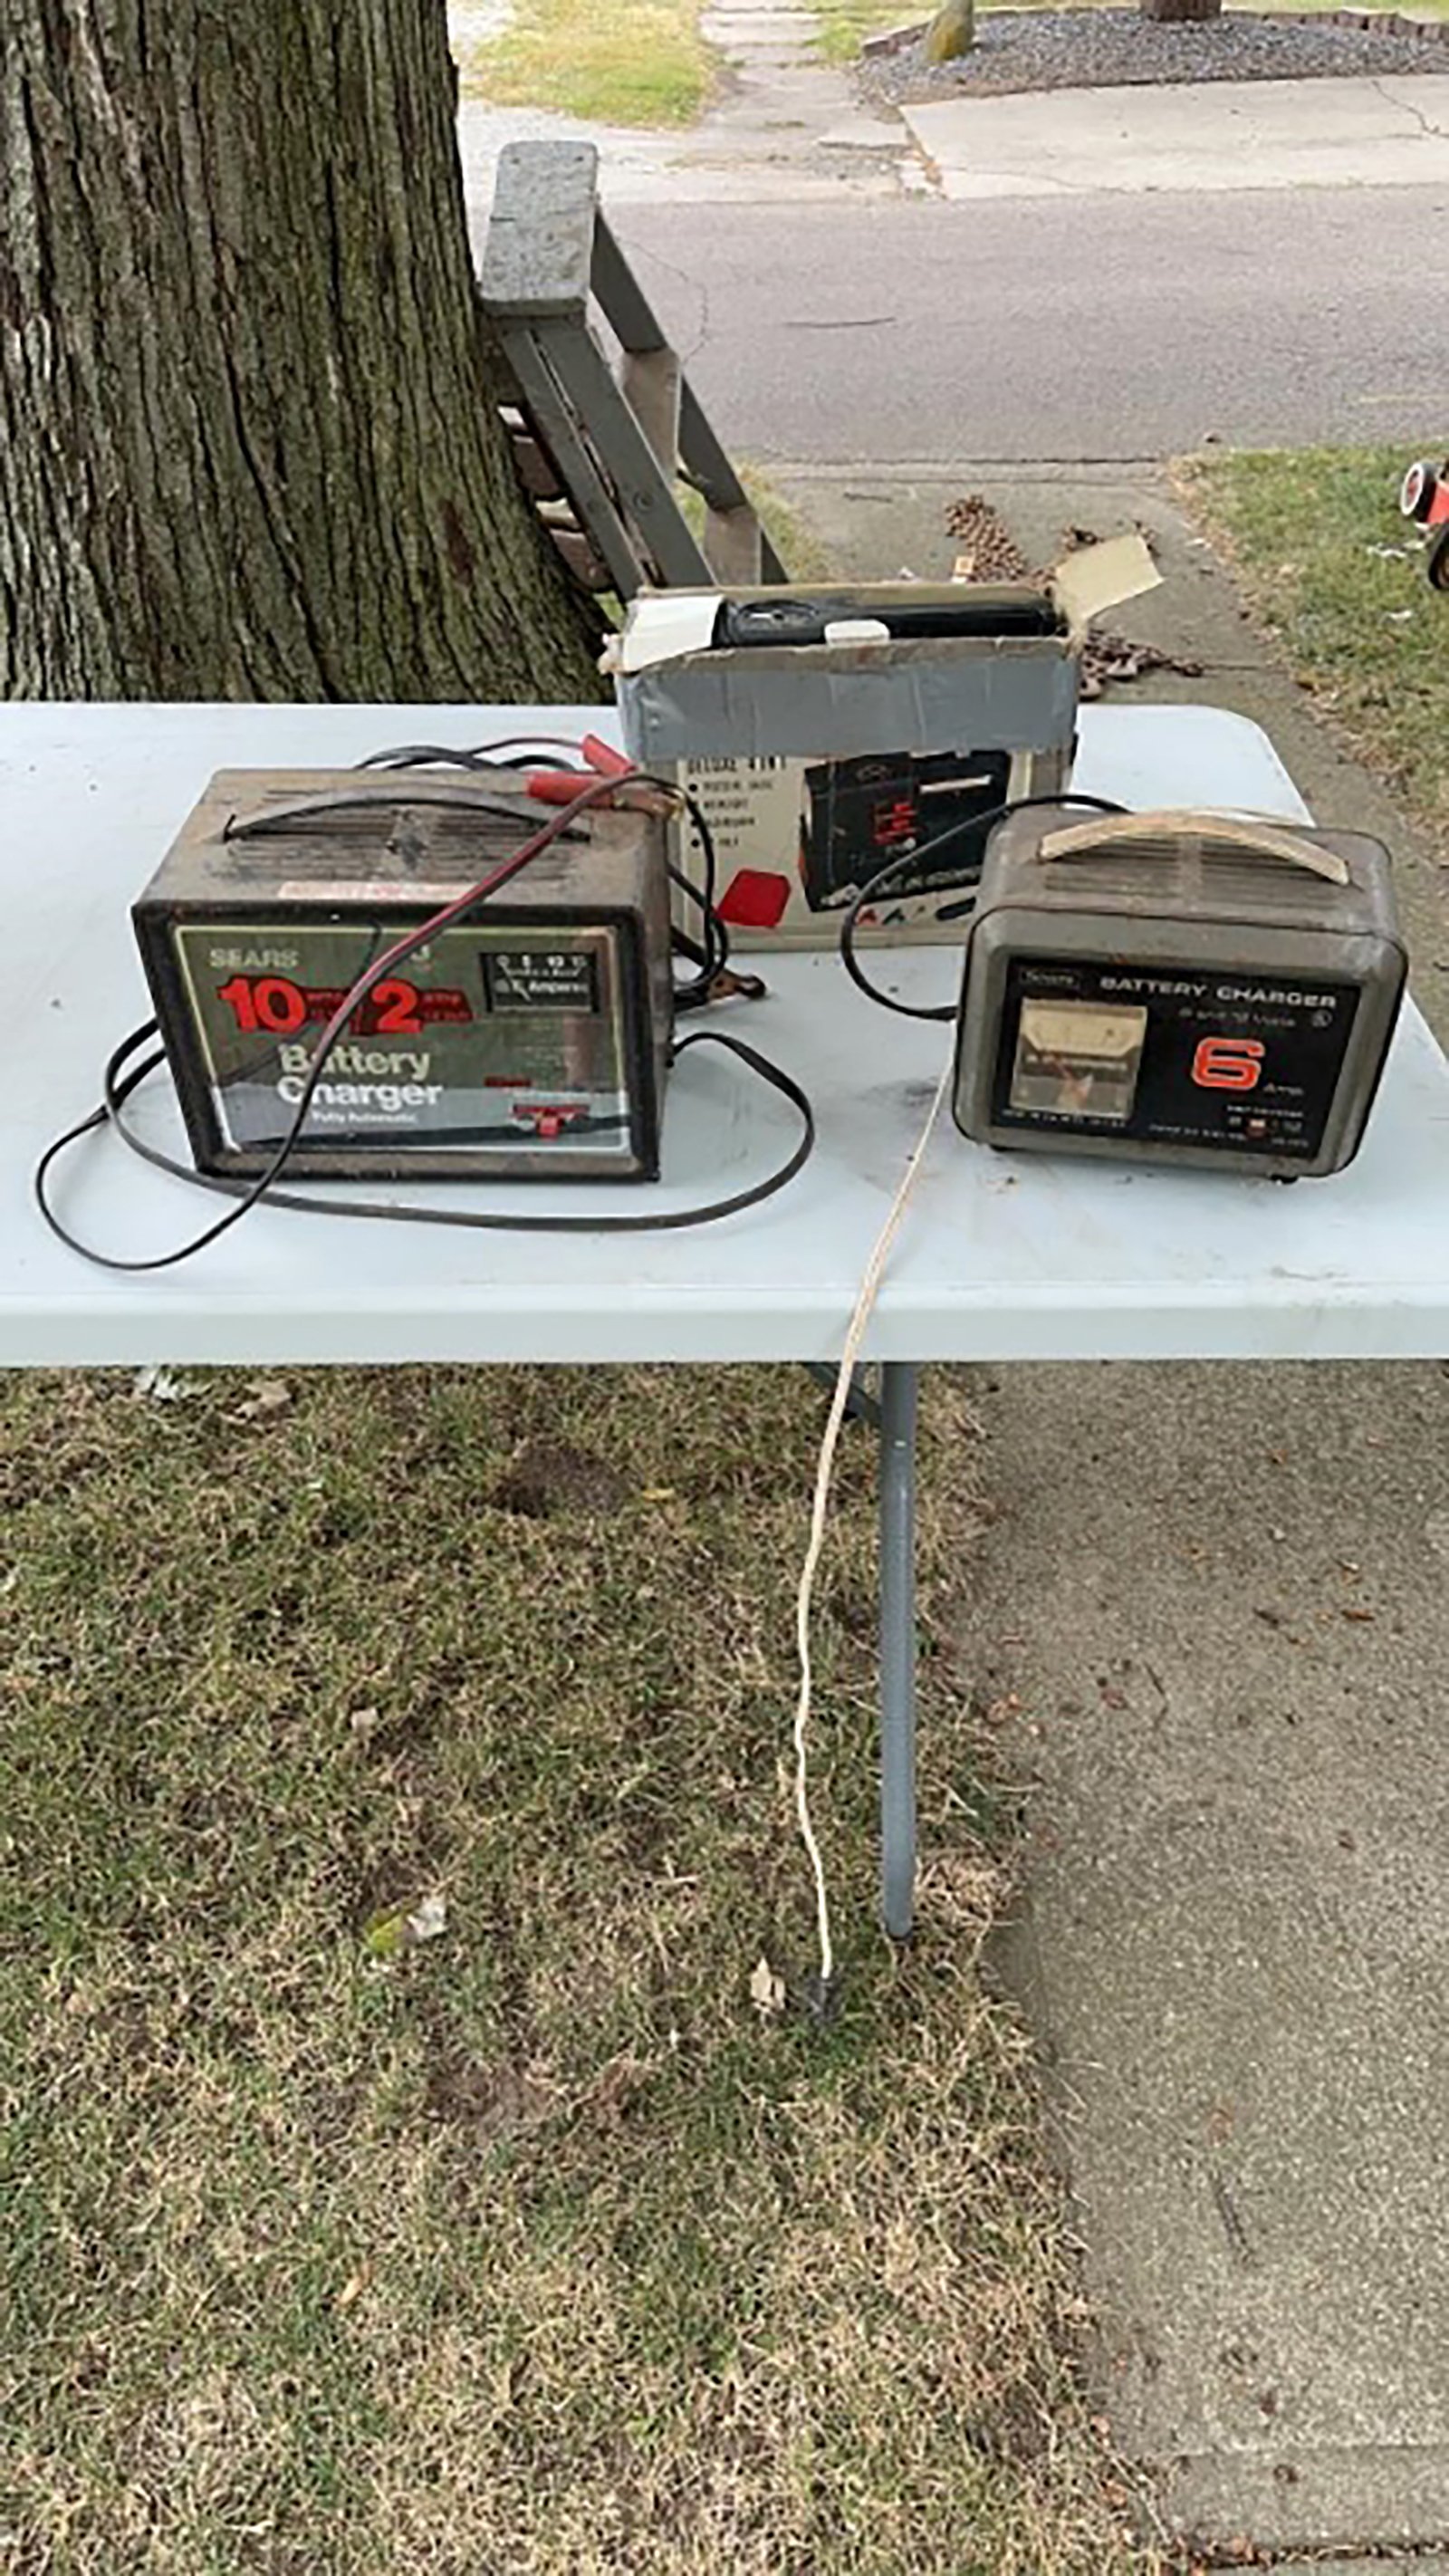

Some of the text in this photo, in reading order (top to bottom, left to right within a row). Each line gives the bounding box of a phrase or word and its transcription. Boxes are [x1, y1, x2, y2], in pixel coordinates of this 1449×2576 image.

[209, 948, 299, 968] SEARS
[218, 977, 307, 1033] 10
[1099, 976, 1337, 1009] BATTERY CHARGER
[1191, 1036, 1265, 1091] 6
